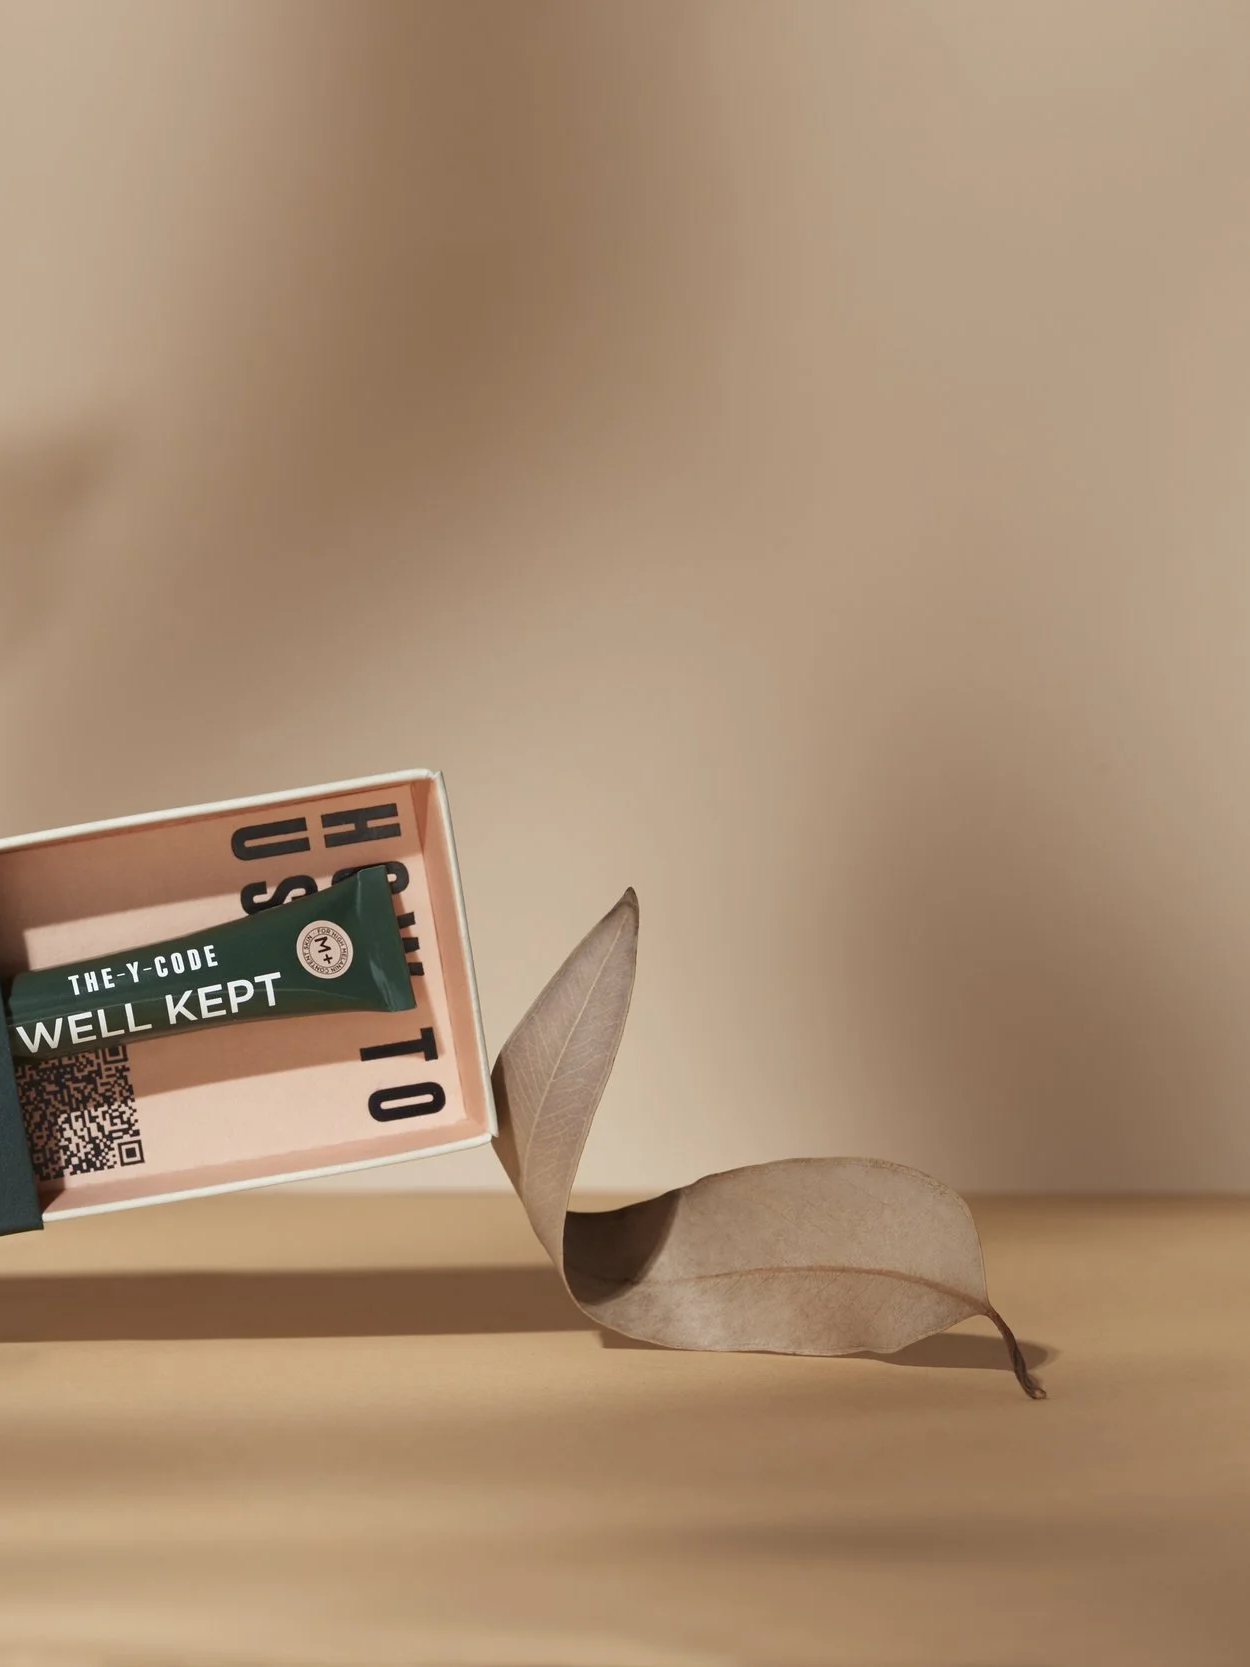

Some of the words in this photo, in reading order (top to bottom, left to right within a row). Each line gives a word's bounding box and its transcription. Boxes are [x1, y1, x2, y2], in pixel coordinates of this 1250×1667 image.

[67, 944, 219, 996] THE-Y-CODE
[16, 1002, 153, 1053] WELL
[165, 971, 282, 1025] KEPT
[359, 1026, 446, 1122] TO
